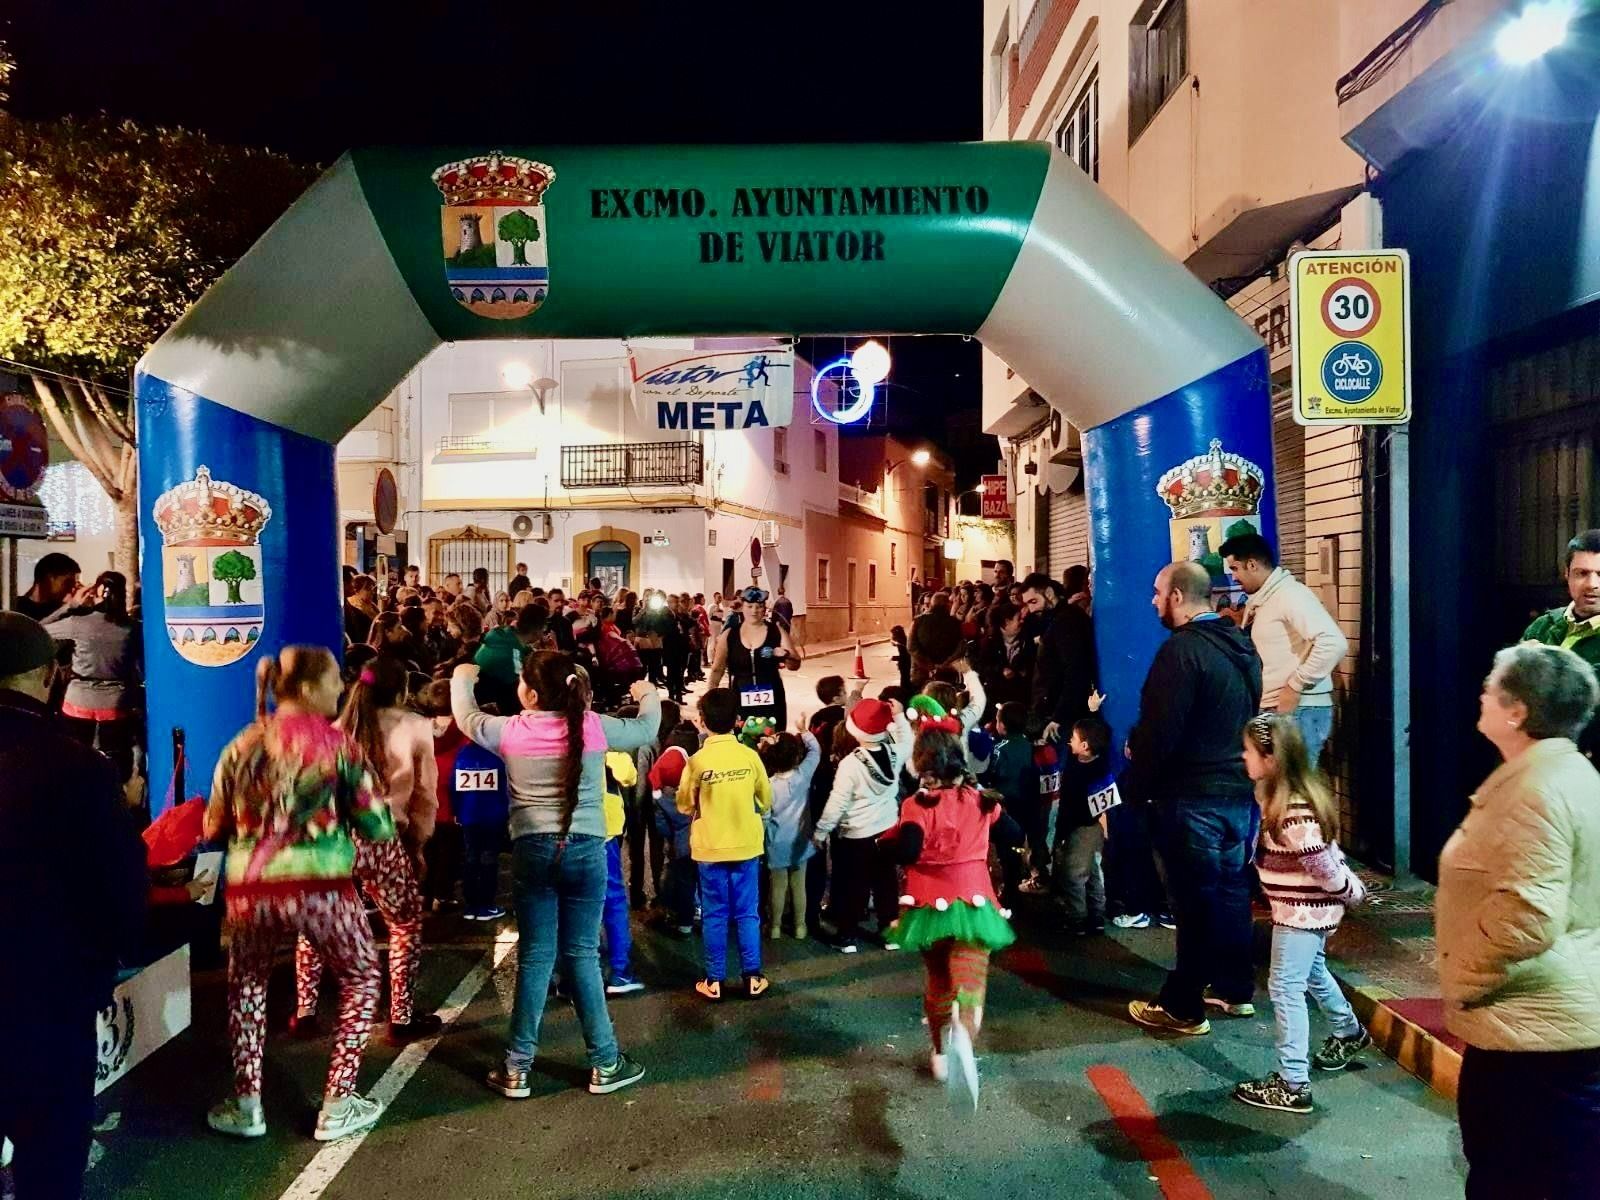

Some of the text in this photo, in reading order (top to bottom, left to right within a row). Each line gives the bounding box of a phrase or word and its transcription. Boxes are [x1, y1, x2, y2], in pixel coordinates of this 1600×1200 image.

[590, 185, 990, 219] EXCMO. AYUNTAMIENTO
[699, 229, 886, 263] DE VIATOR
[1306, 258, 1397, 275] ATENCIÓN
[1334, 294, 1370, 320] 30
[630, 348, 748, 386] Viator
[1334, 377, 1371, 391] CICLOCALLE
[657, 400, 769, 430] META
[984, 480, 1006, 496] HIPE
[984, 500, 1008, 515] BAZA
[745, 692, 771, 705] 142
[459, 772, 496, 789] 214
[1091, 787, 1115, 813] 137
